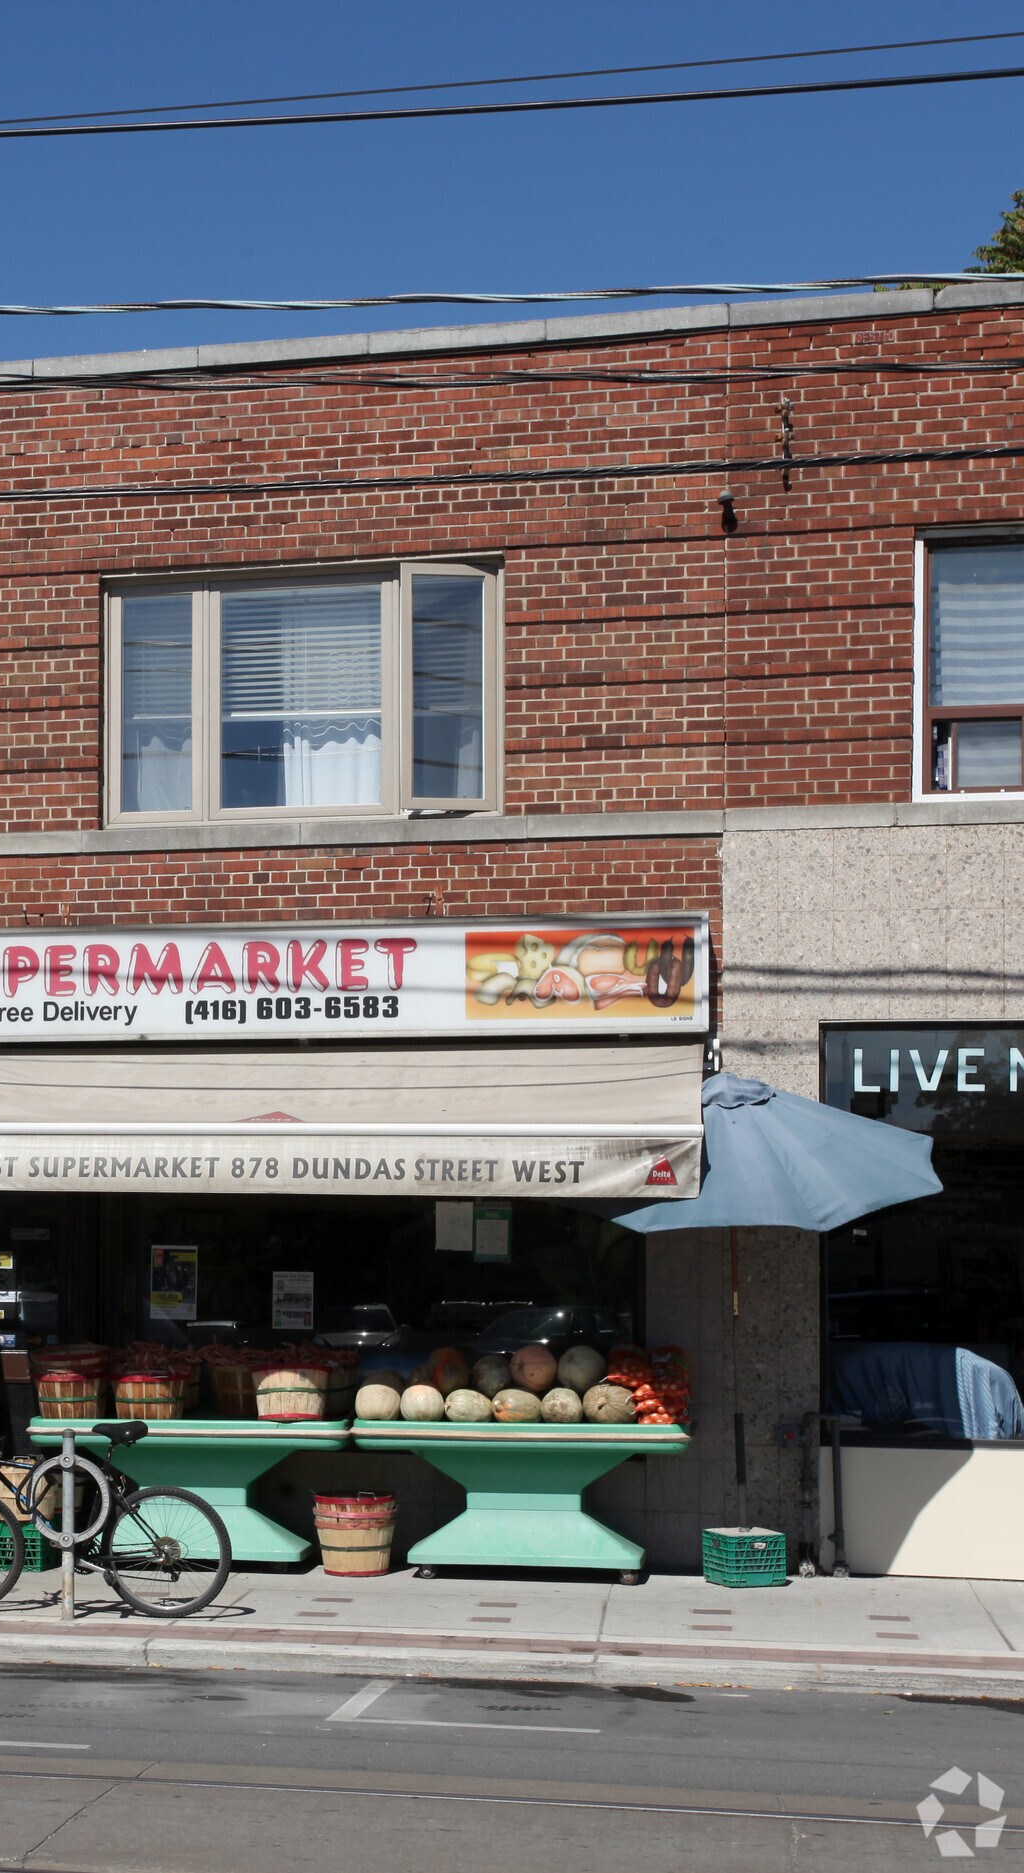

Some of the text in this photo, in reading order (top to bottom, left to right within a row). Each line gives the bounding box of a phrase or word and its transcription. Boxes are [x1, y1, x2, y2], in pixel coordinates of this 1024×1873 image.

[43, 1000, 138, 1026] Delivery
[184, 996, 400, 1024] (416) 603-6583
[854, 1048, 985, 1092] LIVE
[28, 1156, 220, 1179] SUPERMARKET
[231, 1157, 279, 1179] 878
[292, 1157, 406, 1181] DUNDAS
[414, 1158, 498, 1182] STREET
[512, 1160, 585, 1183] WEST
